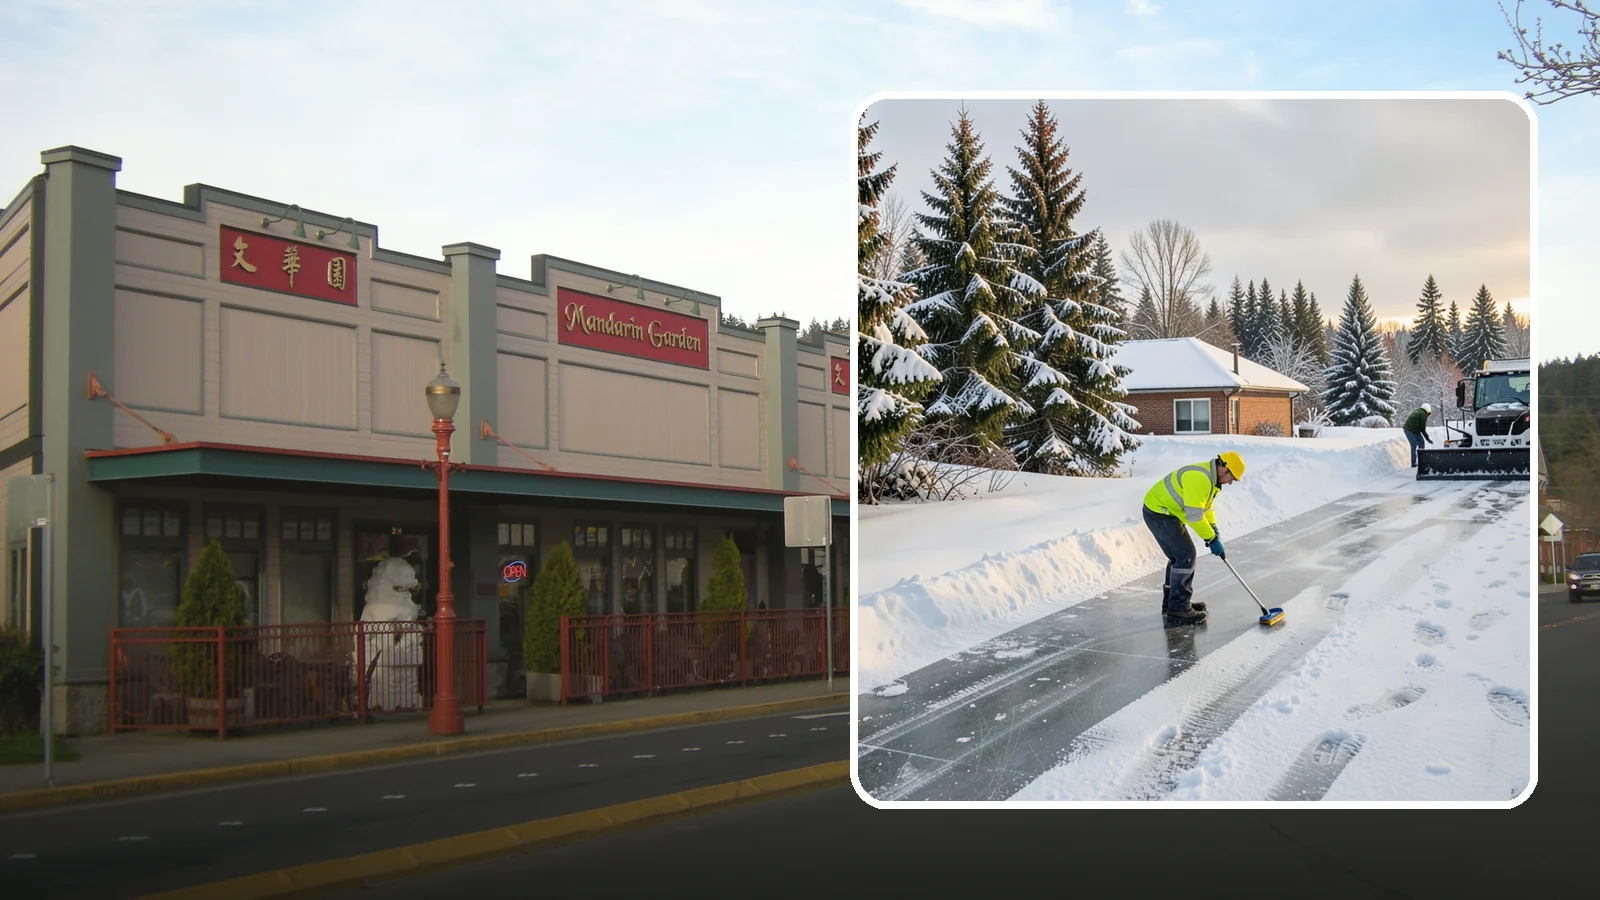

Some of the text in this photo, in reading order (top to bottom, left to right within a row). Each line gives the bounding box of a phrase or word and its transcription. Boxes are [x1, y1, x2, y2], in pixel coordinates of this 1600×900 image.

[230, 235, 347, 291] 文華園
[564, 302, 702, 352] Mandarin Garden
[503, 565, 527, 578] OPEN
